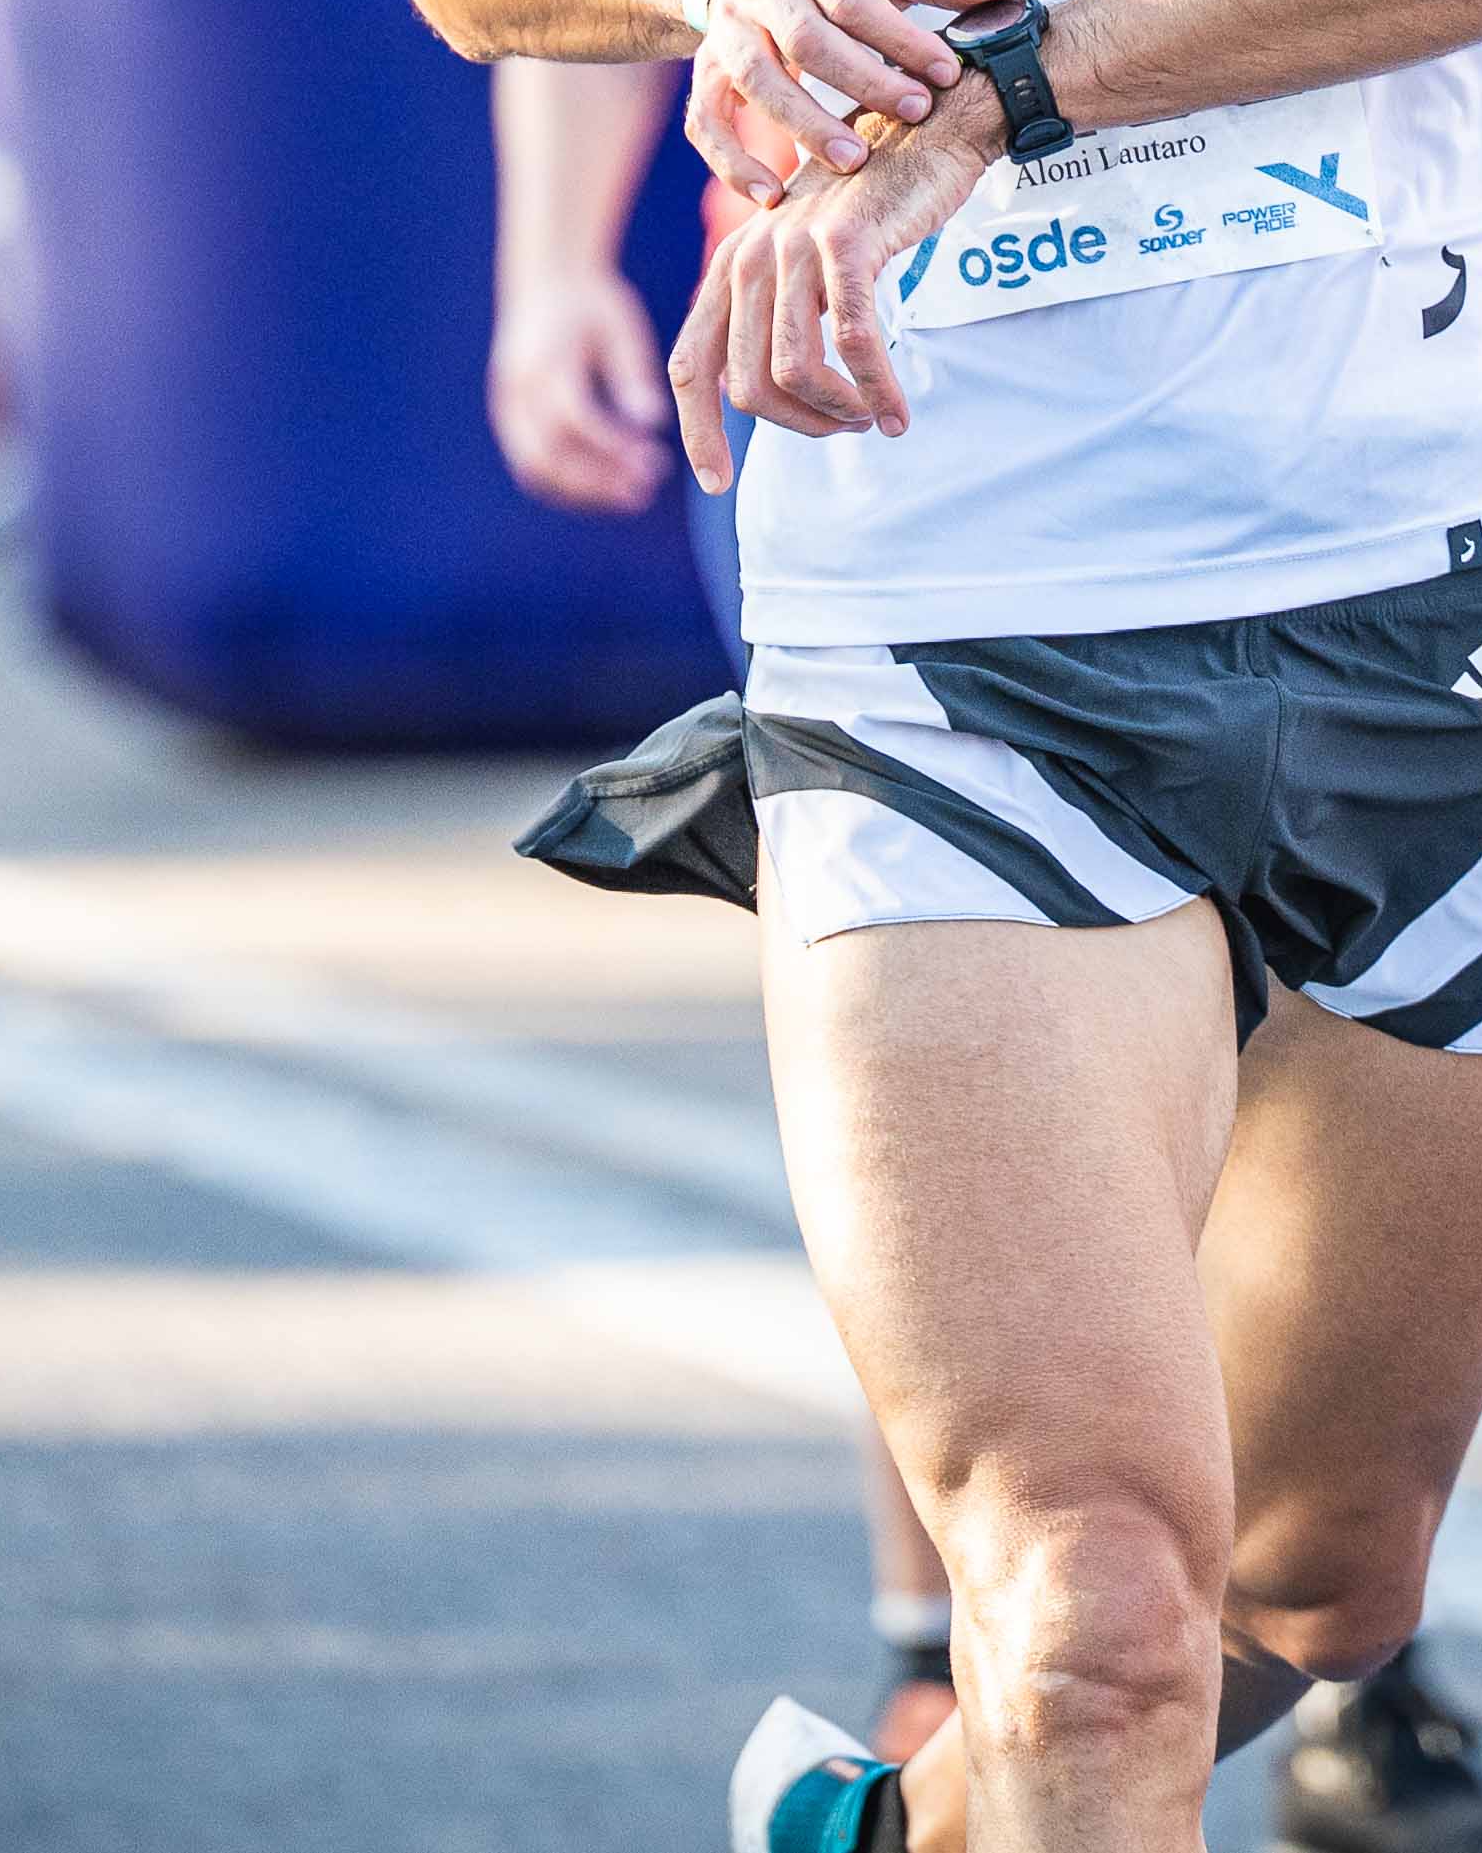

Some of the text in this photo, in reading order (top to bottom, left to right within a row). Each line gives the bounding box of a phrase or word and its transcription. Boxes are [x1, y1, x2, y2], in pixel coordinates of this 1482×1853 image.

[1016, 134, 1207, 189] Aloni Lautaro
[1222, 202, 1296, 227] POWER
[958, 218, 1107, 289] osde
